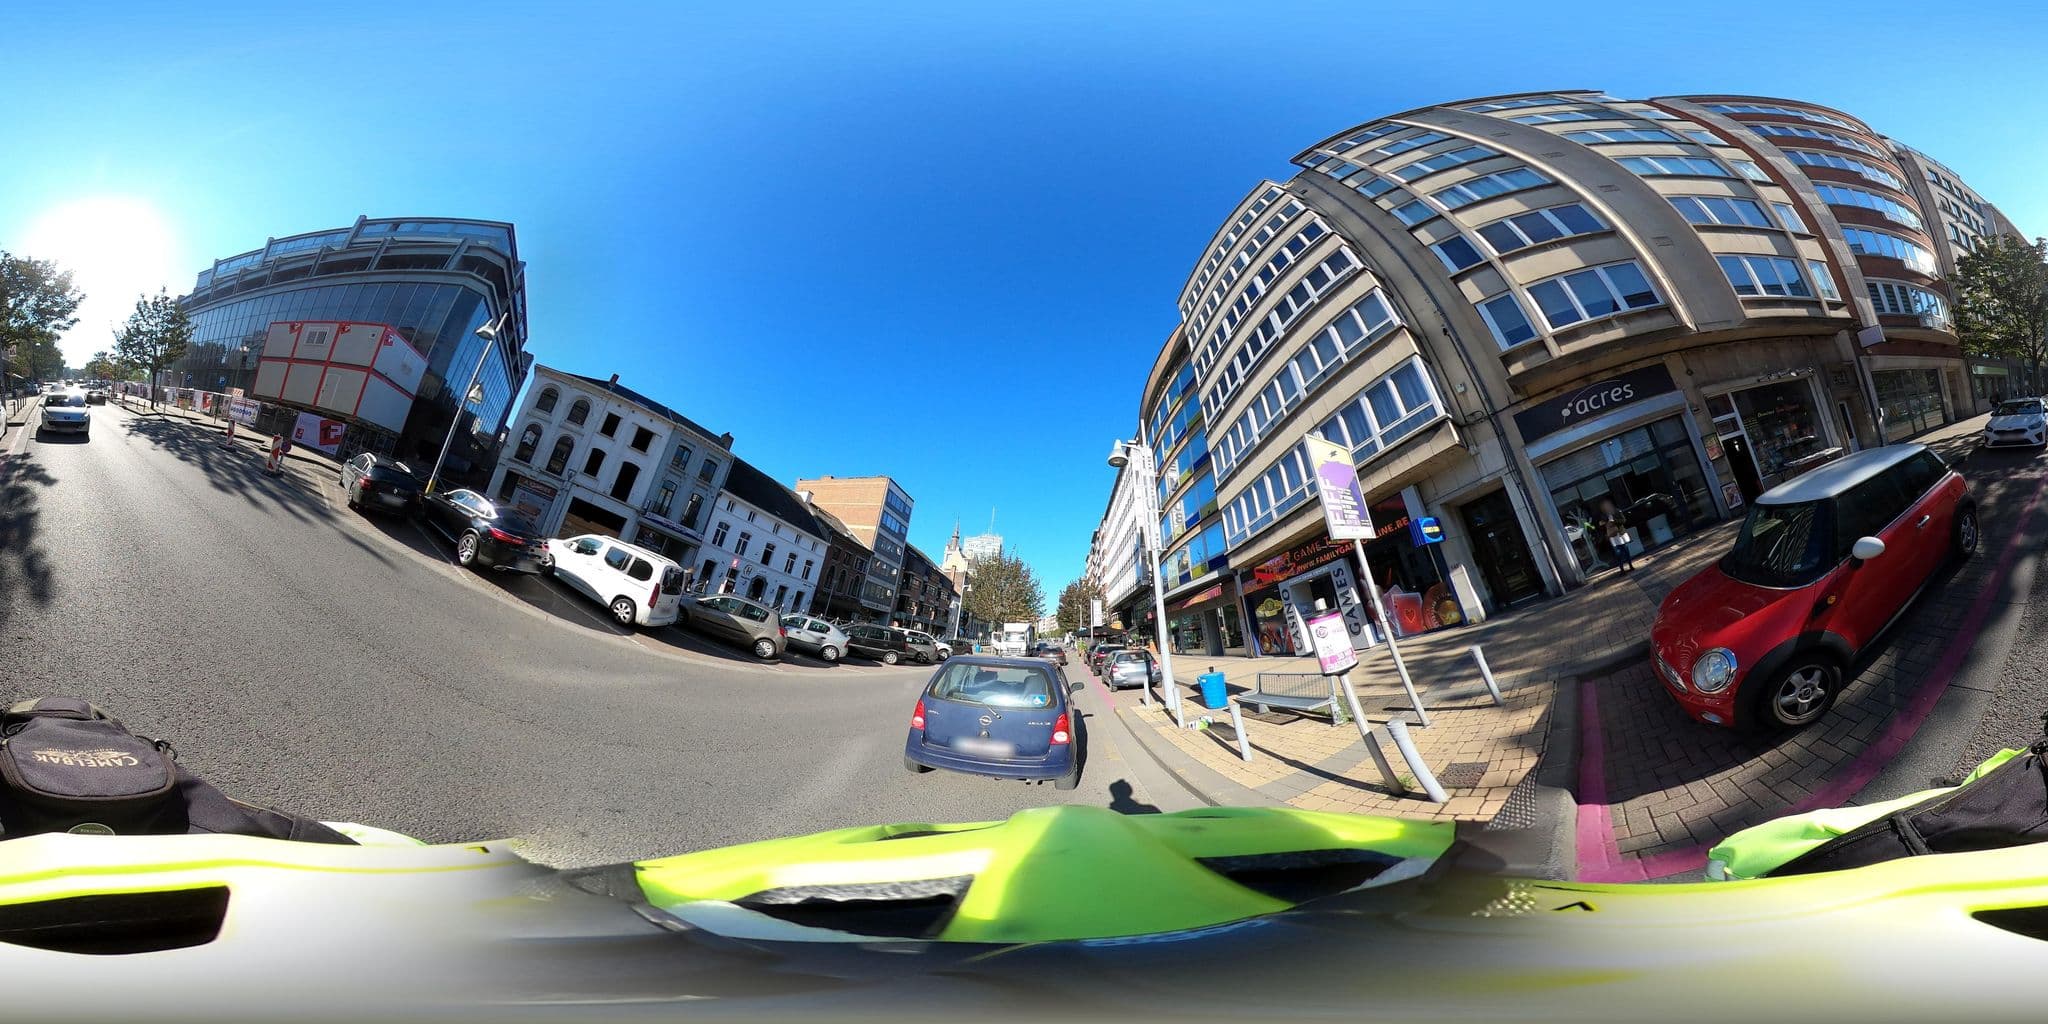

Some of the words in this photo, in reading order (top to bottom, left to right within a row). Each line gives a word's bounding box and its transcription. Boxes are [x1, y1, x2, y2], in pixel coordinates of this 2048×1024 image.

[1575, 384, 1634, 414] acres
[1319, 477, 1346, 525] FIFF
[1293, 542, 1322, 561] GAME
[1281, 588, 1303, 650] CASINO
[1333, 567, 1362, 636] GAMES
[36, 754, 139, 768] CAMELBAK
